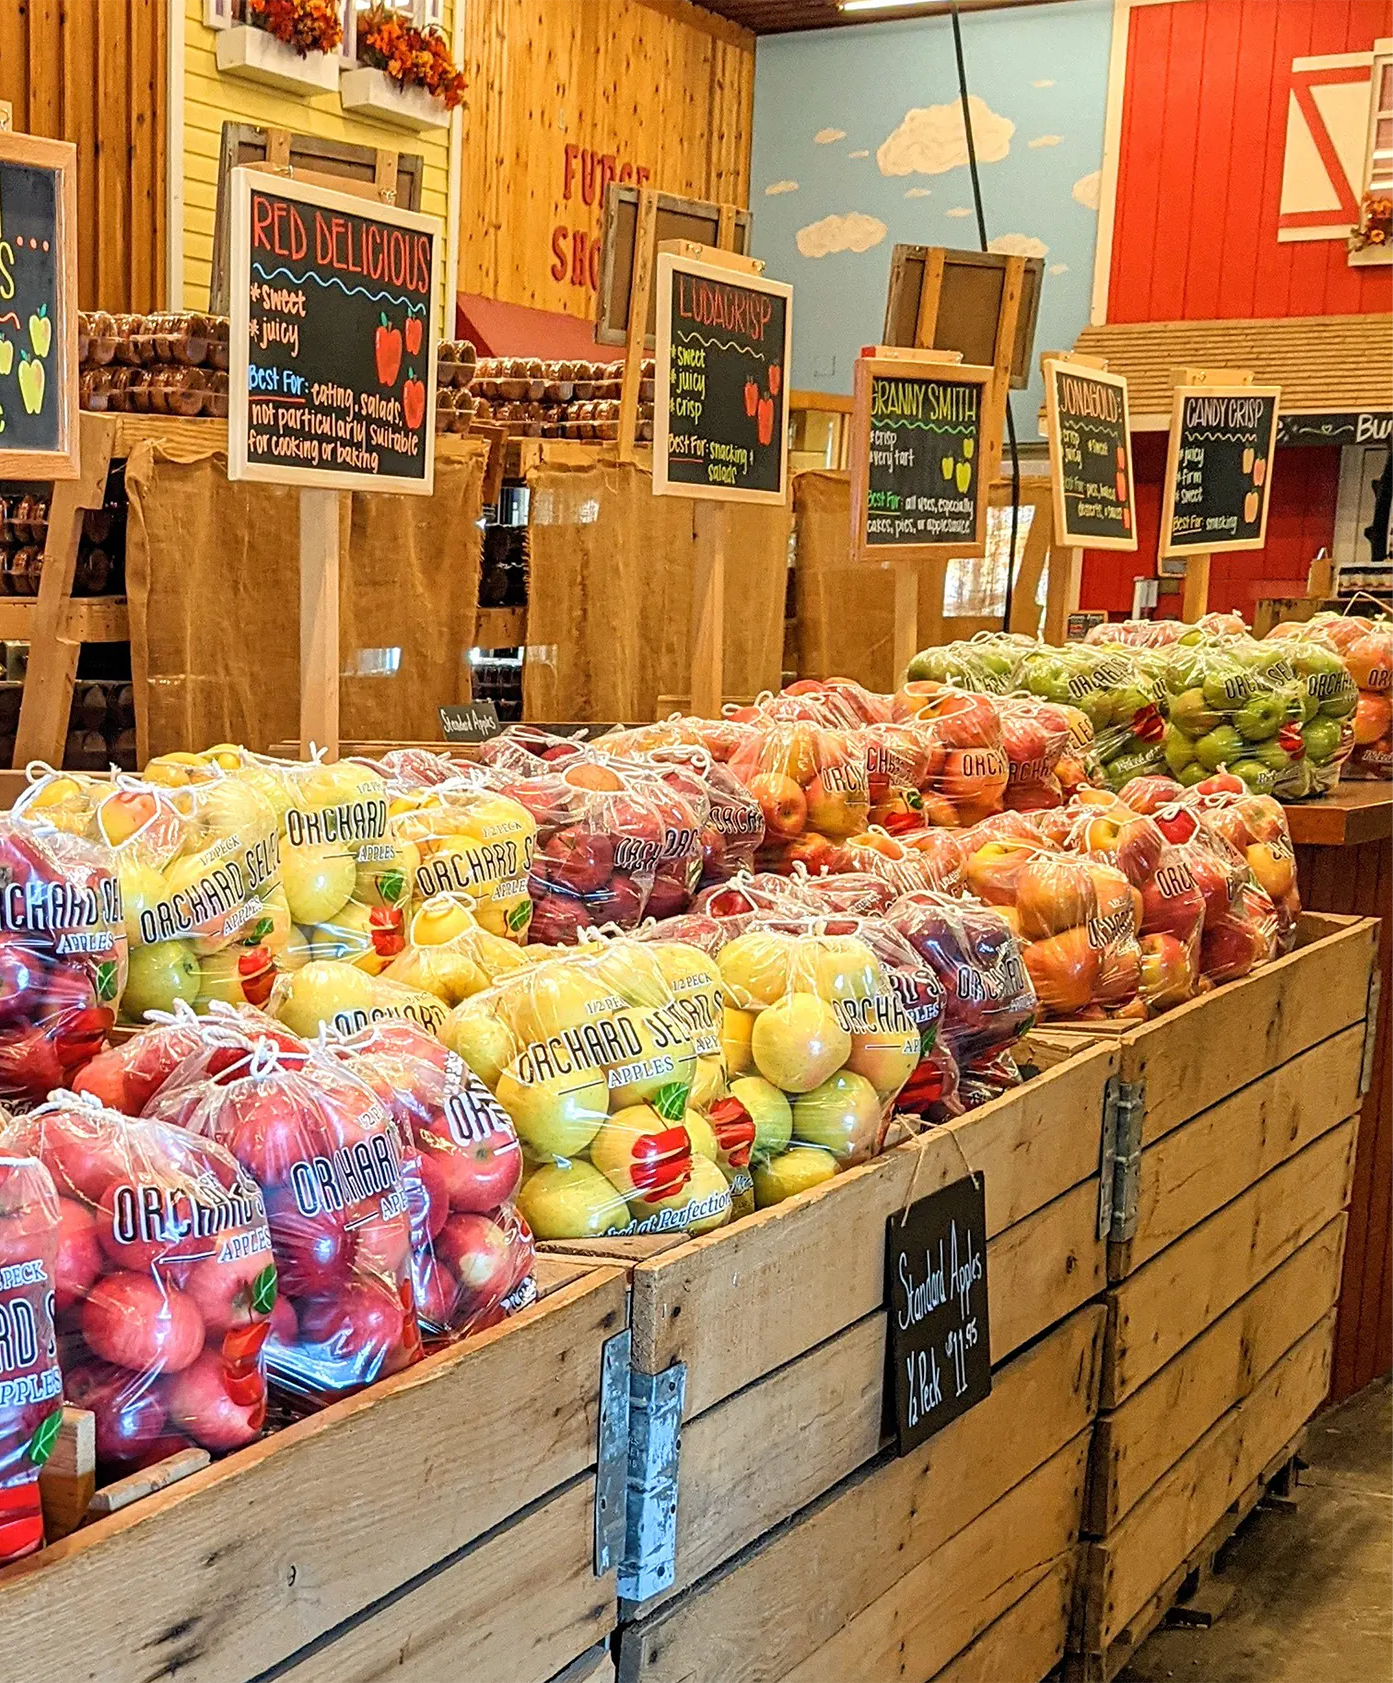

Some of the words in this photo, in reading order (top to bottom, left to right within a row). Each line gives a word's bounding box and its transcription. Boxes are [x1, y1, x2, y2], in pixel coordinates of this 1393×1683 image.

[253, 196, 308, 261] RED
[314, 210, 431, 294] DELICIOUS
[262, 288, 307, 318] sweet
[679, 278, 773, 342] LUDACRISP
[258, 320, 300, 358] juicy
[677, 346, 706, 369] sweet
[248, 364, 281, 391] Best
[283, 369, 309, 397] For:
[676, 369, 706, 400] juicy
[676, 398, 703, 426] crisp
[871, 380, 927, 419] GRANNY
[928, 383, 977, 423] SMITH
[1186, 399, 1228, 428] CANDY
[1228, 399, 1264, 428] CRISP
[252, 404, 276, 425] not
[277, 407, 366, 452] particularly
[369, 424, 419, 457] suitable
[248, 431, 269, 454] for
[271, 437, 320, 467] cooking
[321, 443, 335, 462] or
[336, 441, 380, 474] baking
[668, 432, 690, 455] Best
[709, 441, 748, 475] snacking
[872, 452, 894, 474] very
[894, 449, 915, 467] tart
[287, 799, 388, 847] ORCHARD
[214, 834, 241, 861] PECK
[356, 844, 396, 862] APPLES
[415, 840, 517, 898] ORCHARD
[140, 860, 246, 945] ORCHARD
[56, 931, 115, 955] APPLES
[686, 972, 713, 989] PECK
[517, 1016, 644, 1086] ORCHARD
[606, 1054, 676, 1089] APPLES
[657, 1190, 732, 1233] Perfection
[4, 1259, 49, 1291] PECK
[898, 1238, 947, 1331] Standard
[949, 1219, 983, 1321] Apples
[917, 1347, 943, 1415] Peck
